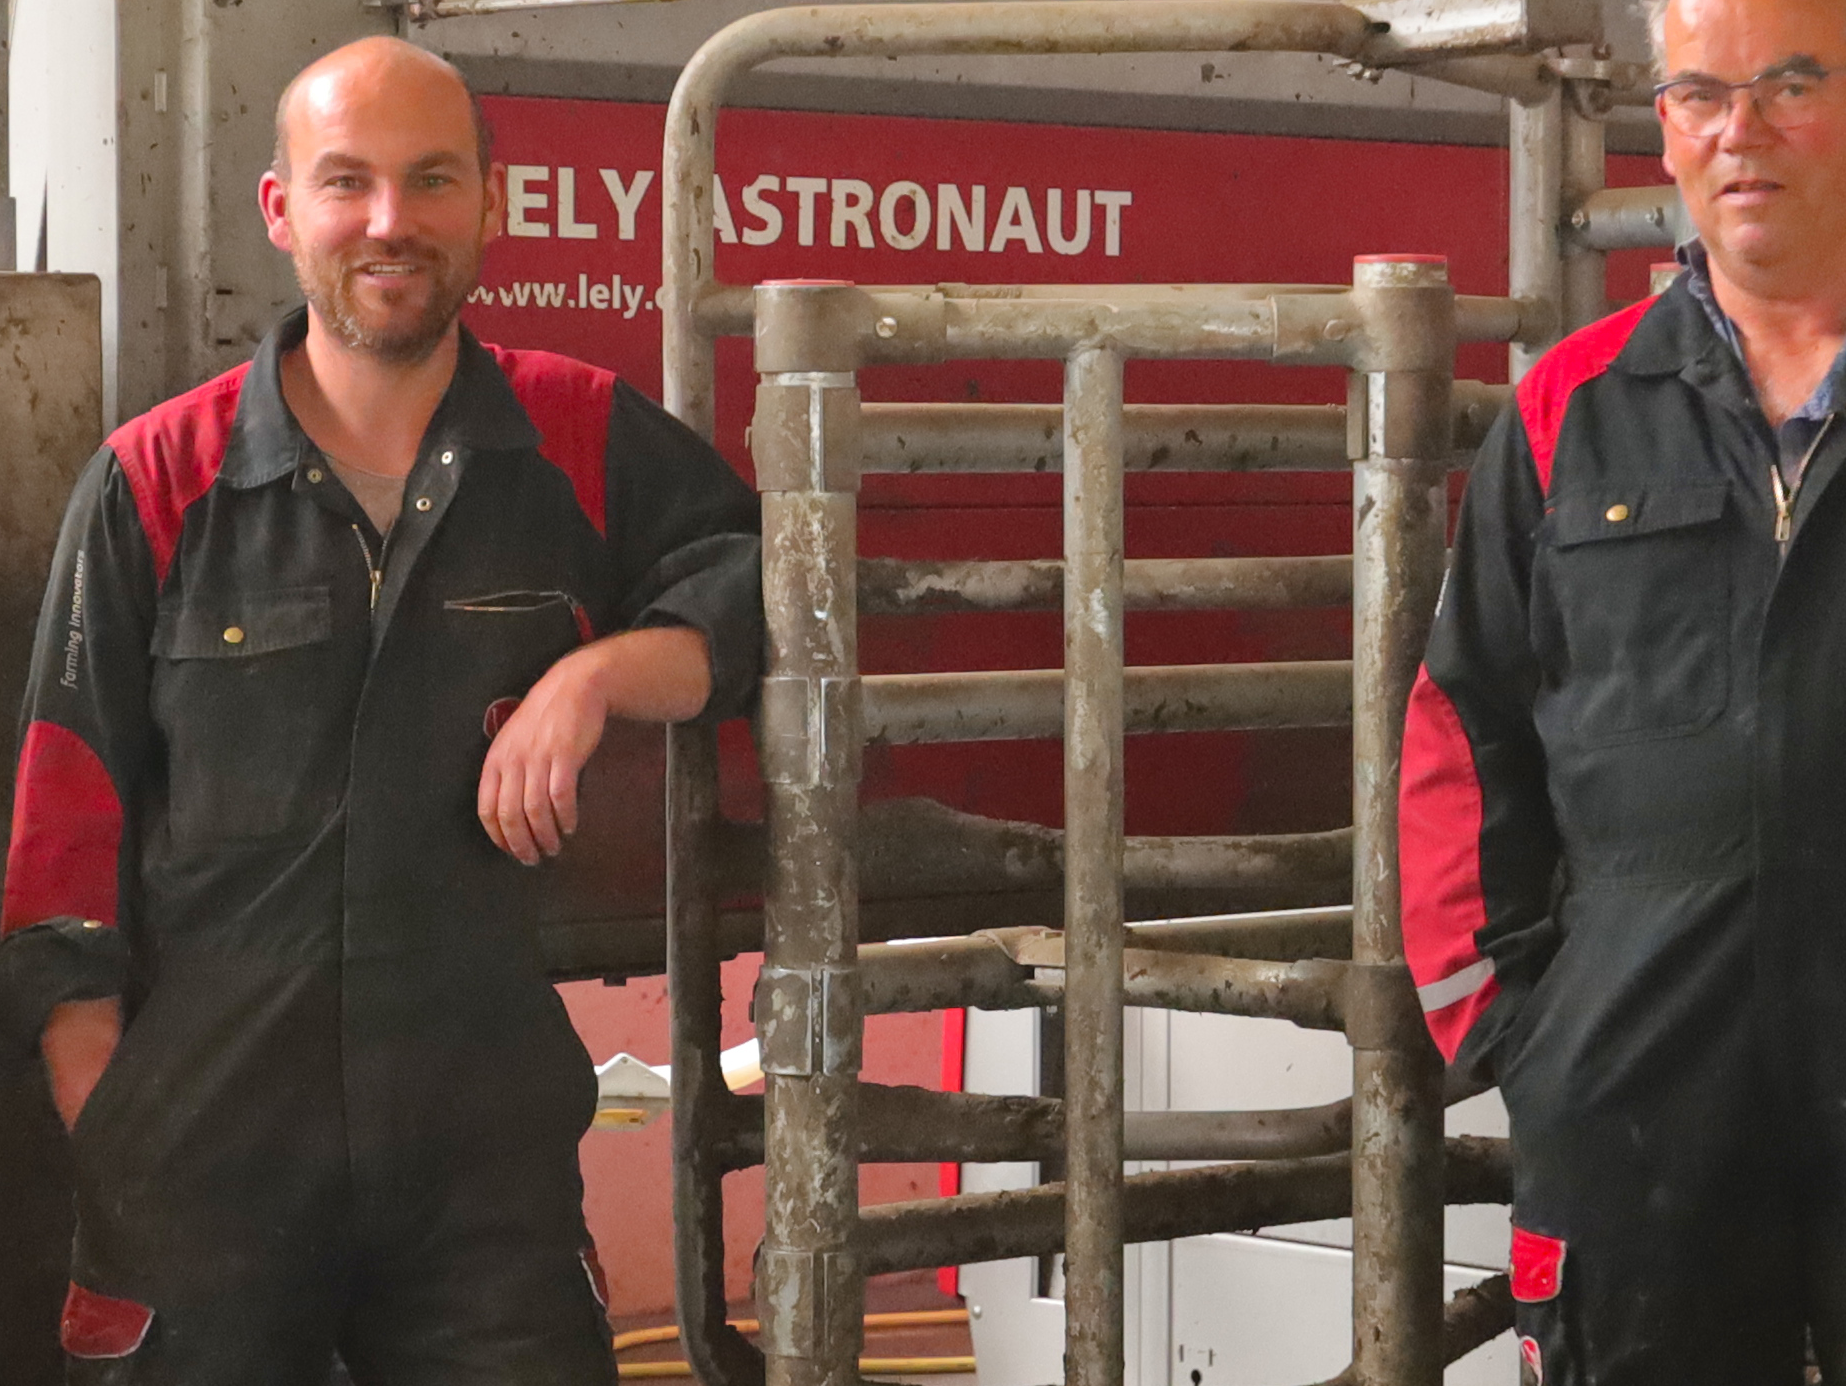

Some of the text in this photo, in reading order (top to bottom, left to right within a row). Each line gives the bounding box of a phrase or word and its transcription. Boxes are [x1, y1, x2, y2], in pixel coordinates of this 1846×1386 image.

[498, 164, 655, 241] ELY
[59, 549, 85, 690] farming innovators
